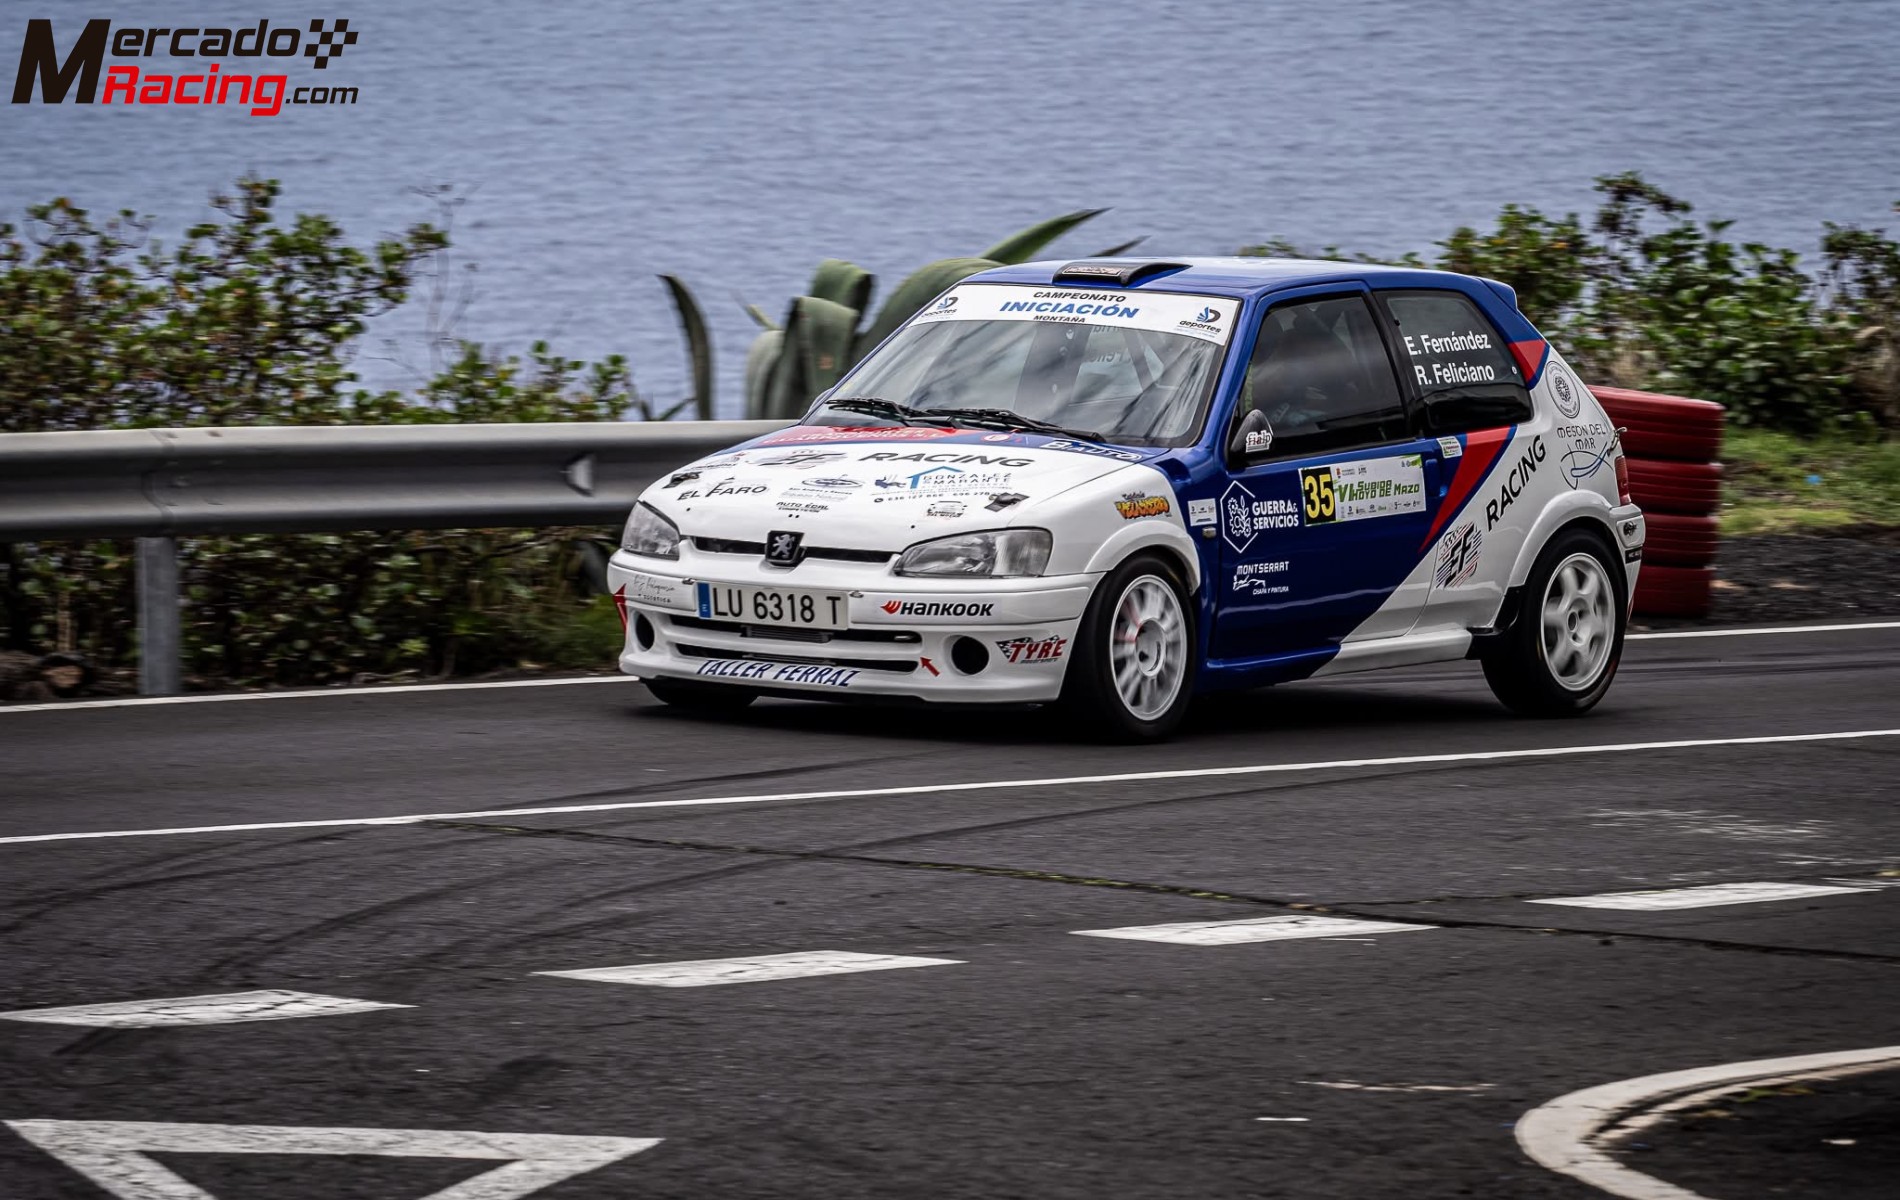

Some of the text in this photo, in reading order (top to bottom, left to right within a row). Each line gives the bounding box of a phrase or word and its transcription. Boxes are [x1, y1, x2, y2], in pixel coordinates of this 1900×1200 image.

[1033, 291, 1127, 302] CAMPEONATO
[1000, 301, 1139, 319] INICIACIÓN
[1033, 315, 1086, 323] MONTAÑA
[1180, 320, 1221, 333] deportes
[1404, 331, 1491, 356] E. Fernández
[1414, 362, 1495, 385] R. Feliciano
[1556, 423, 1607, 439] MESON DEL
[1575, 437, 1596, 450] MAR
[859, 452, 1035, 467] RACING
[677, 490, 701, 501] EL
[705, 481, 768, 497] FARO
[1485, 435, 1546, 531] RACING
[1304, 474, 1335, 518] 35
[1378, 487, 1391, 498] DE
[1253, 514, 1299, 530] SERVICIOS
[1236, 561, 1290, 575] MONTSERRAT
[713, 588, 743, 618] LU
[753, 591, 816, 623] 6318
[826, 596, 842, 625] T
[1008, 638, 1068, 663] TYRE
[697, 659, 862, 687] TALLER FERRAZ
